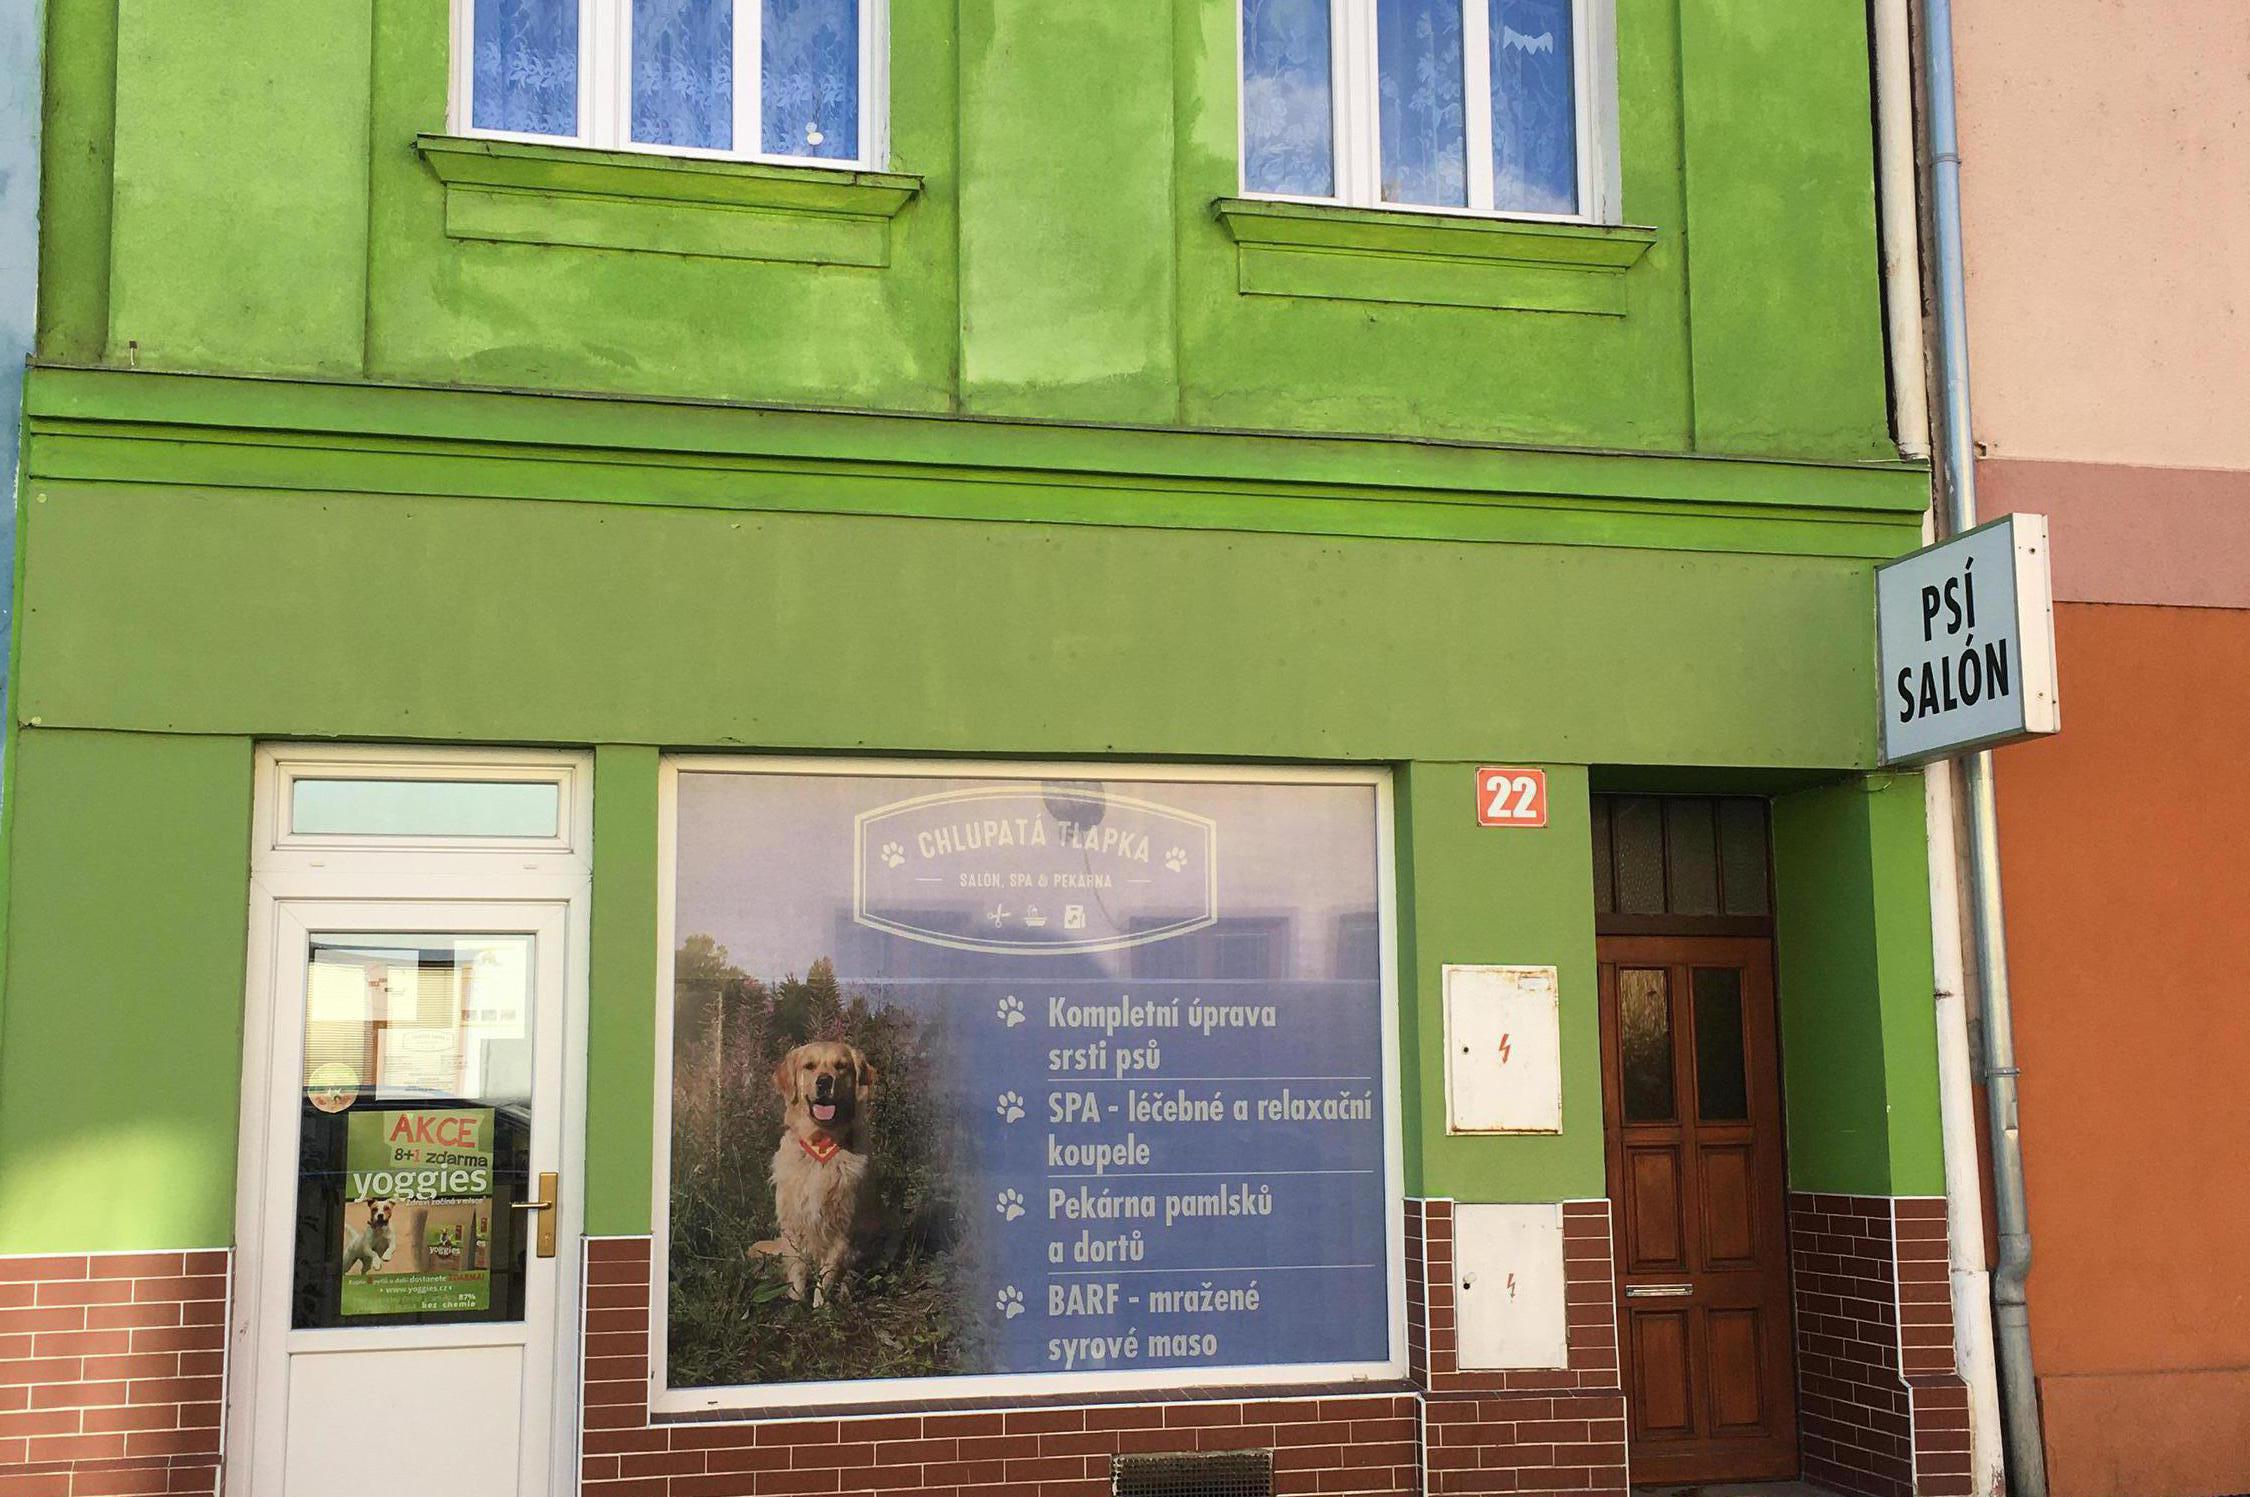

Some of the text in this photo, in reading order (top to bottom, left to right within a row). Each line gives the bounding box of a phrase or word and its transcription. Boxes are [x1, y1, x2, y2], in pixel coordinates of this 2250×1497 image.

[1922, 556, 1975, 641] PSÍ
[1898, 633, 2009, 723] SALÓN
[1486, 776, 1538, 818] 22
[918, 813, 1150, 863] CHLUPATÁ TLAPKA
[1010, 872, 1033, 888] SPA
[1038, 872, 1049, 888] &
[1048, 995, 1277, 1035] Kompletní úprava
[1048, 1039, 1160, 1079] srsti psů
[1048, 1091, 1100, 1123] SPA
[1128, 1090, 1223, 1122] léčebné
[1233, 1100, 1248, 1120] a
[1258, 1088, 1372, 1120] relaxační
[390, 1113, 477, 1148] AKCE
[394, 1148, 488, 1167] 8+1 zdarma
[1048, 1133, 1150, 1174] koupele
[353, 1163, 487, 1202] yoggies
[1048, 1184, 1272, 1226] Pekárna pamlsků
[1048, 1230, 1145, 1263] a dortů
[1048, 1284, 1119, 1316] BARF
[1148, 1280, 1260, 1313] mražené
[1048, 1327, 1218, 1369] syrové maso
